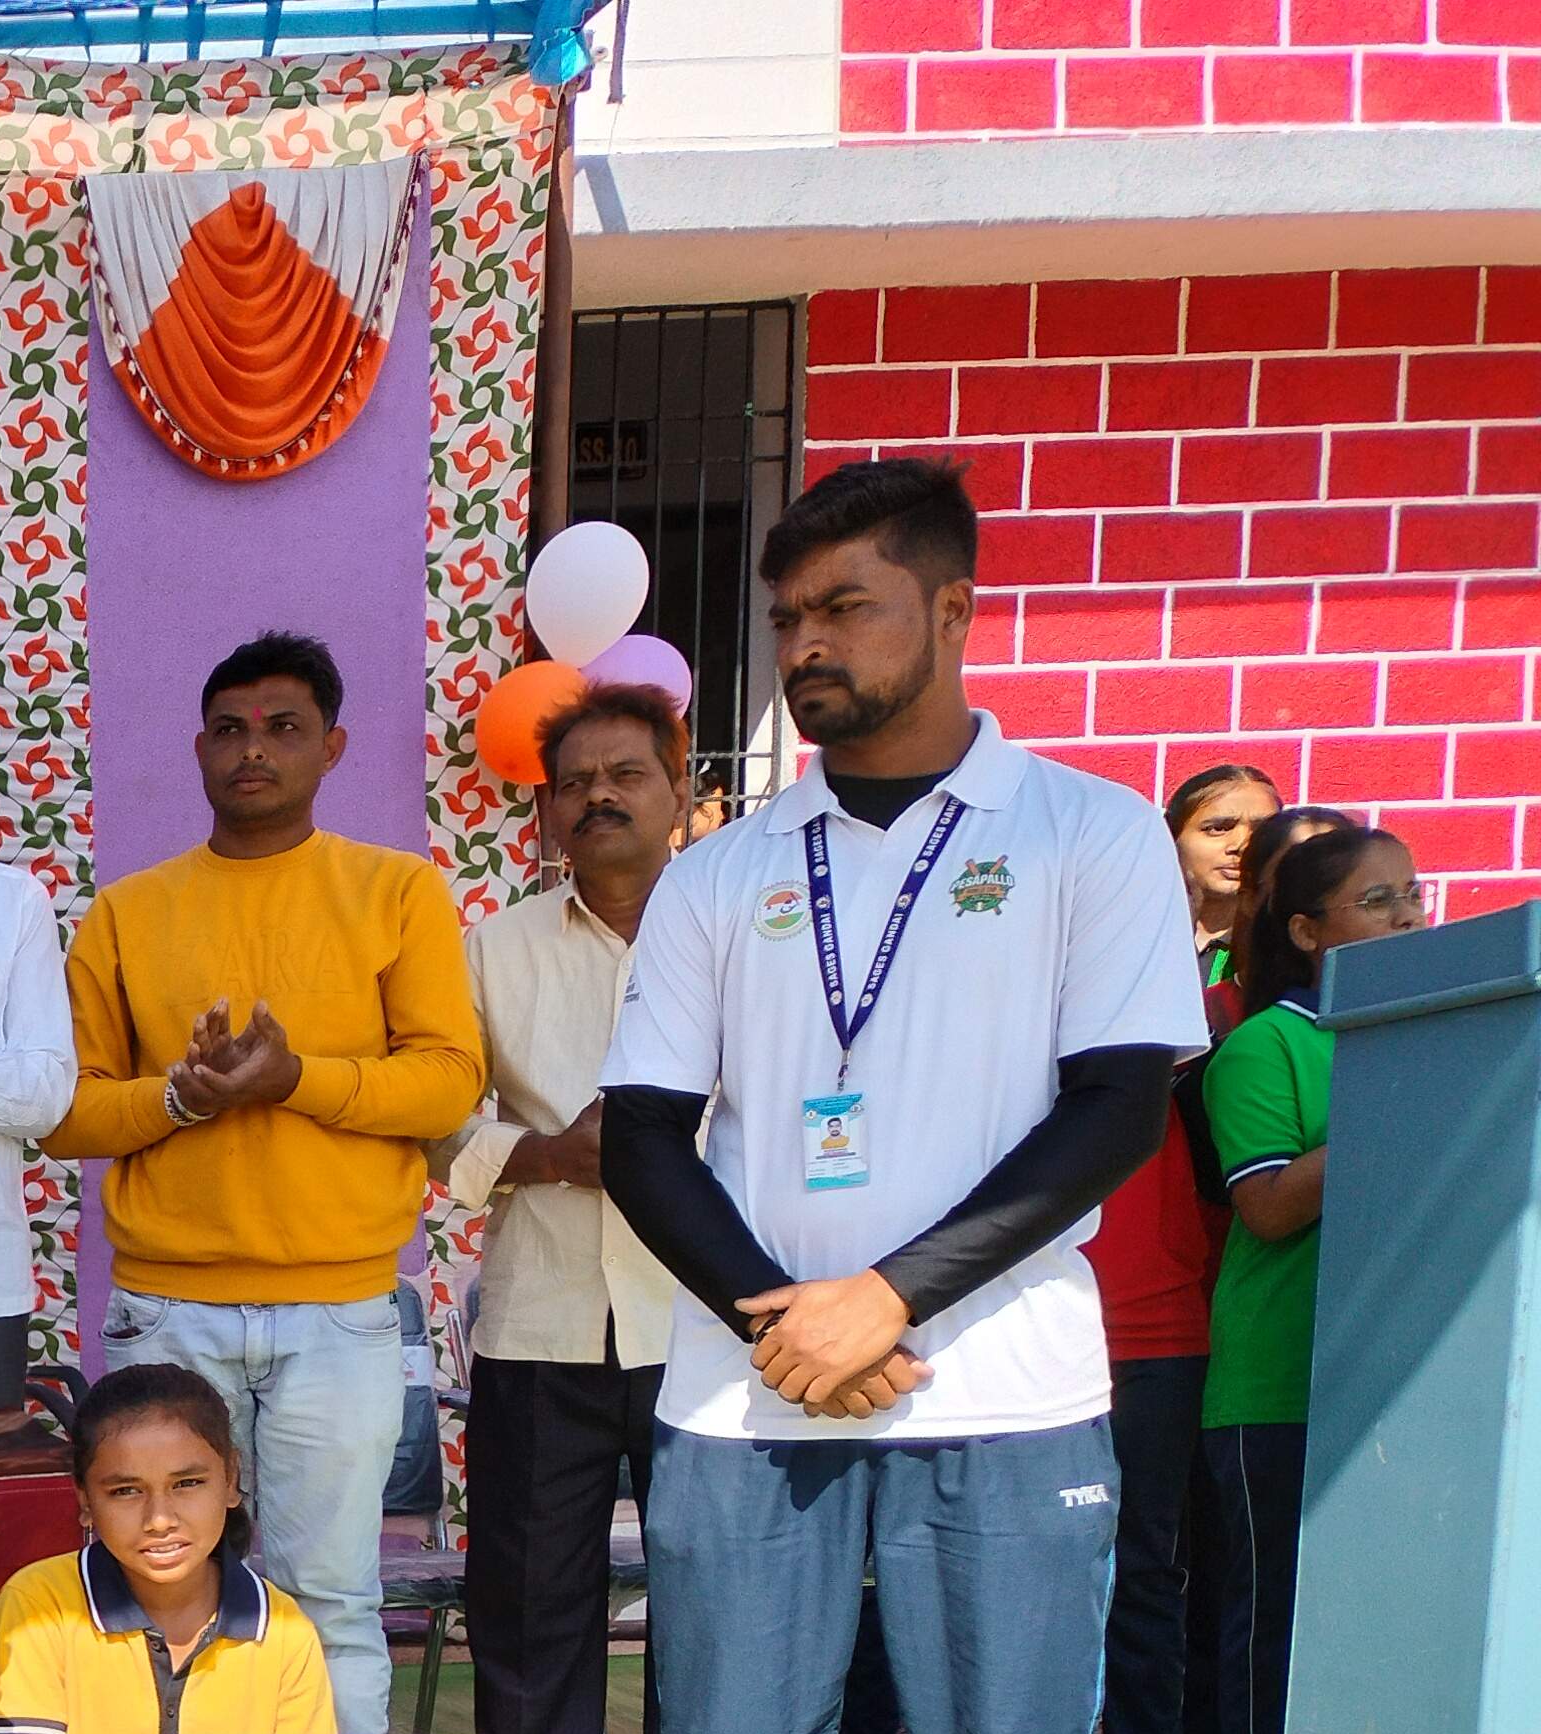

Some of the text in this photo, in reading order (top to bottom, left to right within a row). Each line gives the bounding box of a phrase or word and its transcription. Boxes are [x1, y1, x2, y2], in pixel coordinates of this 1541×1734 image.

[940, 799, 960, 825] GAND
[950, 874, 1014, 893] PESAPALLO
[821, 913, 839, 988] SAGES GANDAI
[867, 913, 905, 989] SAGES GANDAI
[1059, 1483, 1109, 1508] TYKA
